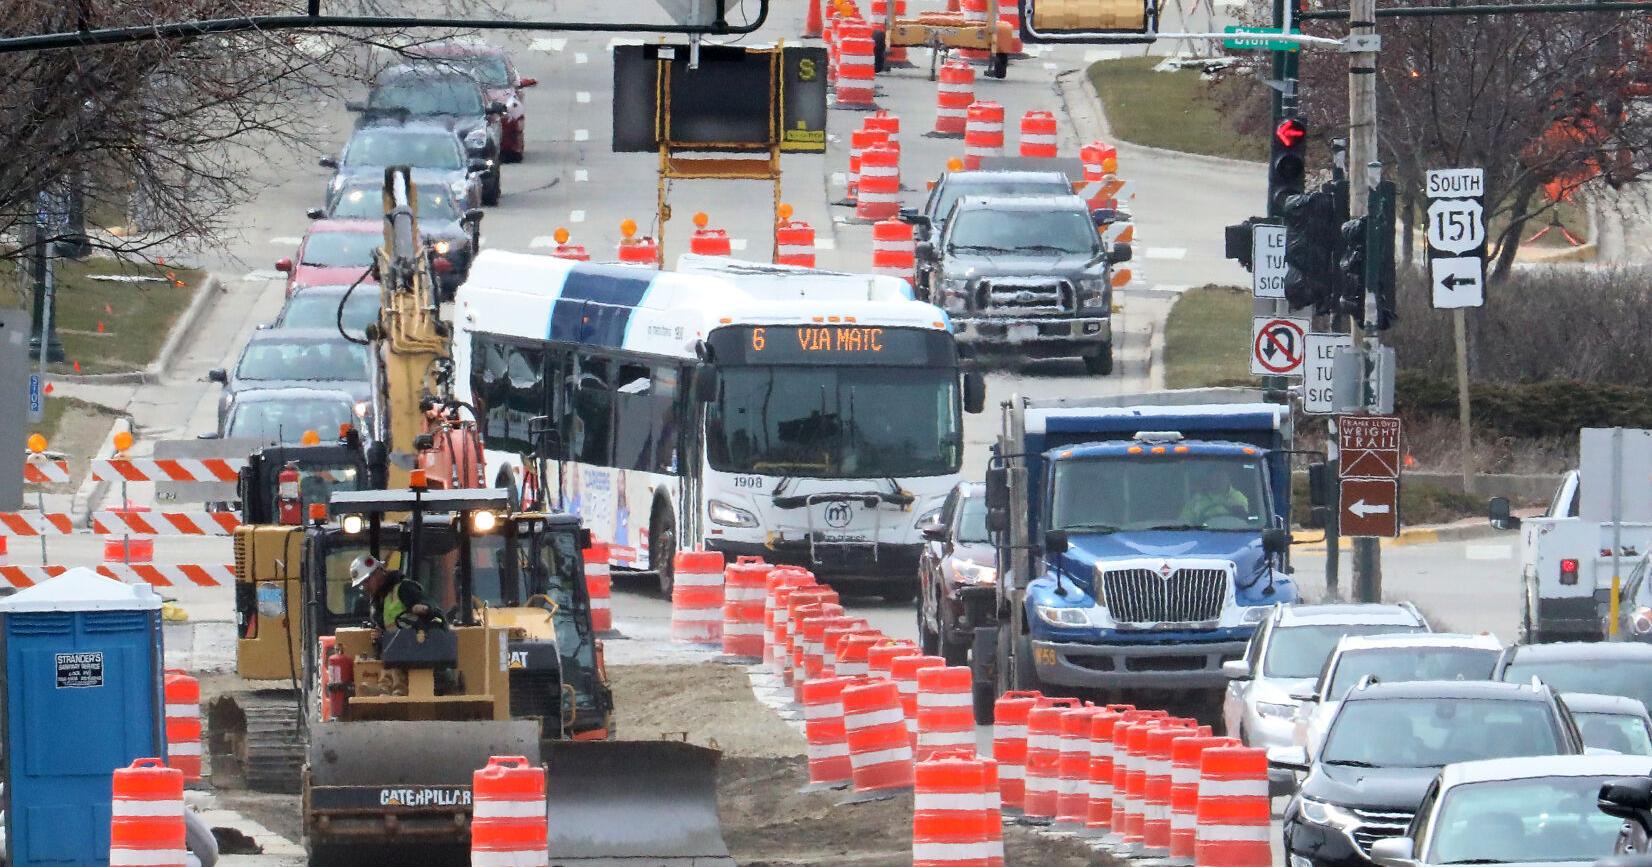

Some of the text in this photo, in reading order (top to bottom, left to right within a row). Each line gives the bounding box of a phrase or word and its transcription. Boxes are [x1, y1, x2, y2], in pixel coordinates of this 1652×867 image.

[1430, 174, 1480, 192] SOUTH
[1437, 210, 1475, 241] 151
[752, 327, 766, 351] 6
[798, 327, 882, 351] VIA MATC
[1343, 427, 1397, 436] WRIGHT
[1343, 435, 1396, 448] TRAIL
[734, 477, 763, 488] 1908
[57, 654, 101, 663] STRANDER'S
[380, 789, 471, 806] CATERPILLAR
